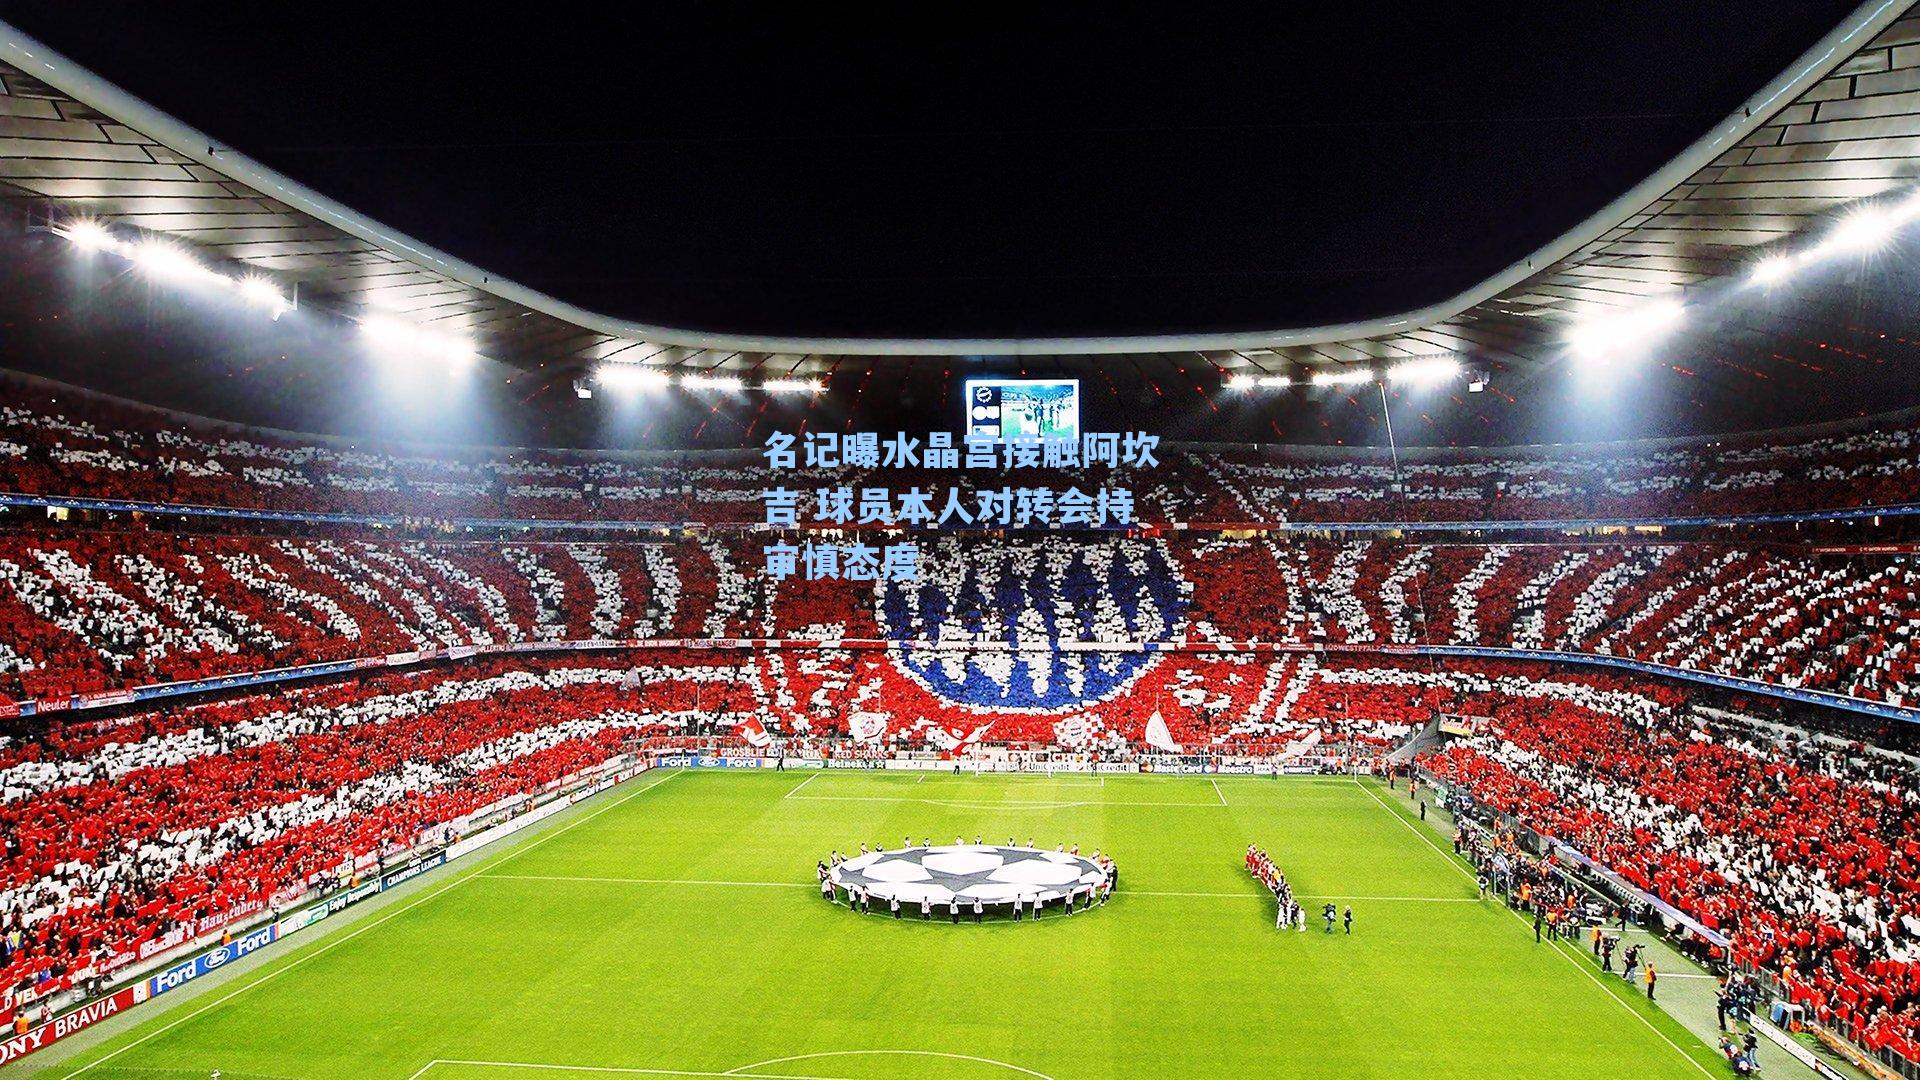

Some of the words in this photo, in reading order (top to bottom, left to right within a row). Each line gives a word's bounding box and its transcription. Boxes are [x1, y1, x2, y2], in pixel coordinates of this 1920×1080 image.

[661, 758, 692, 767] Ford
[727, 759, 757, 768] Ford
[1154, 765, 1203, 773] MasteCard
[238, 928, 271, 957] Ford
[156, 960, 197, 993] Ford
[54, 997, 118, 1039] BRAVIA
